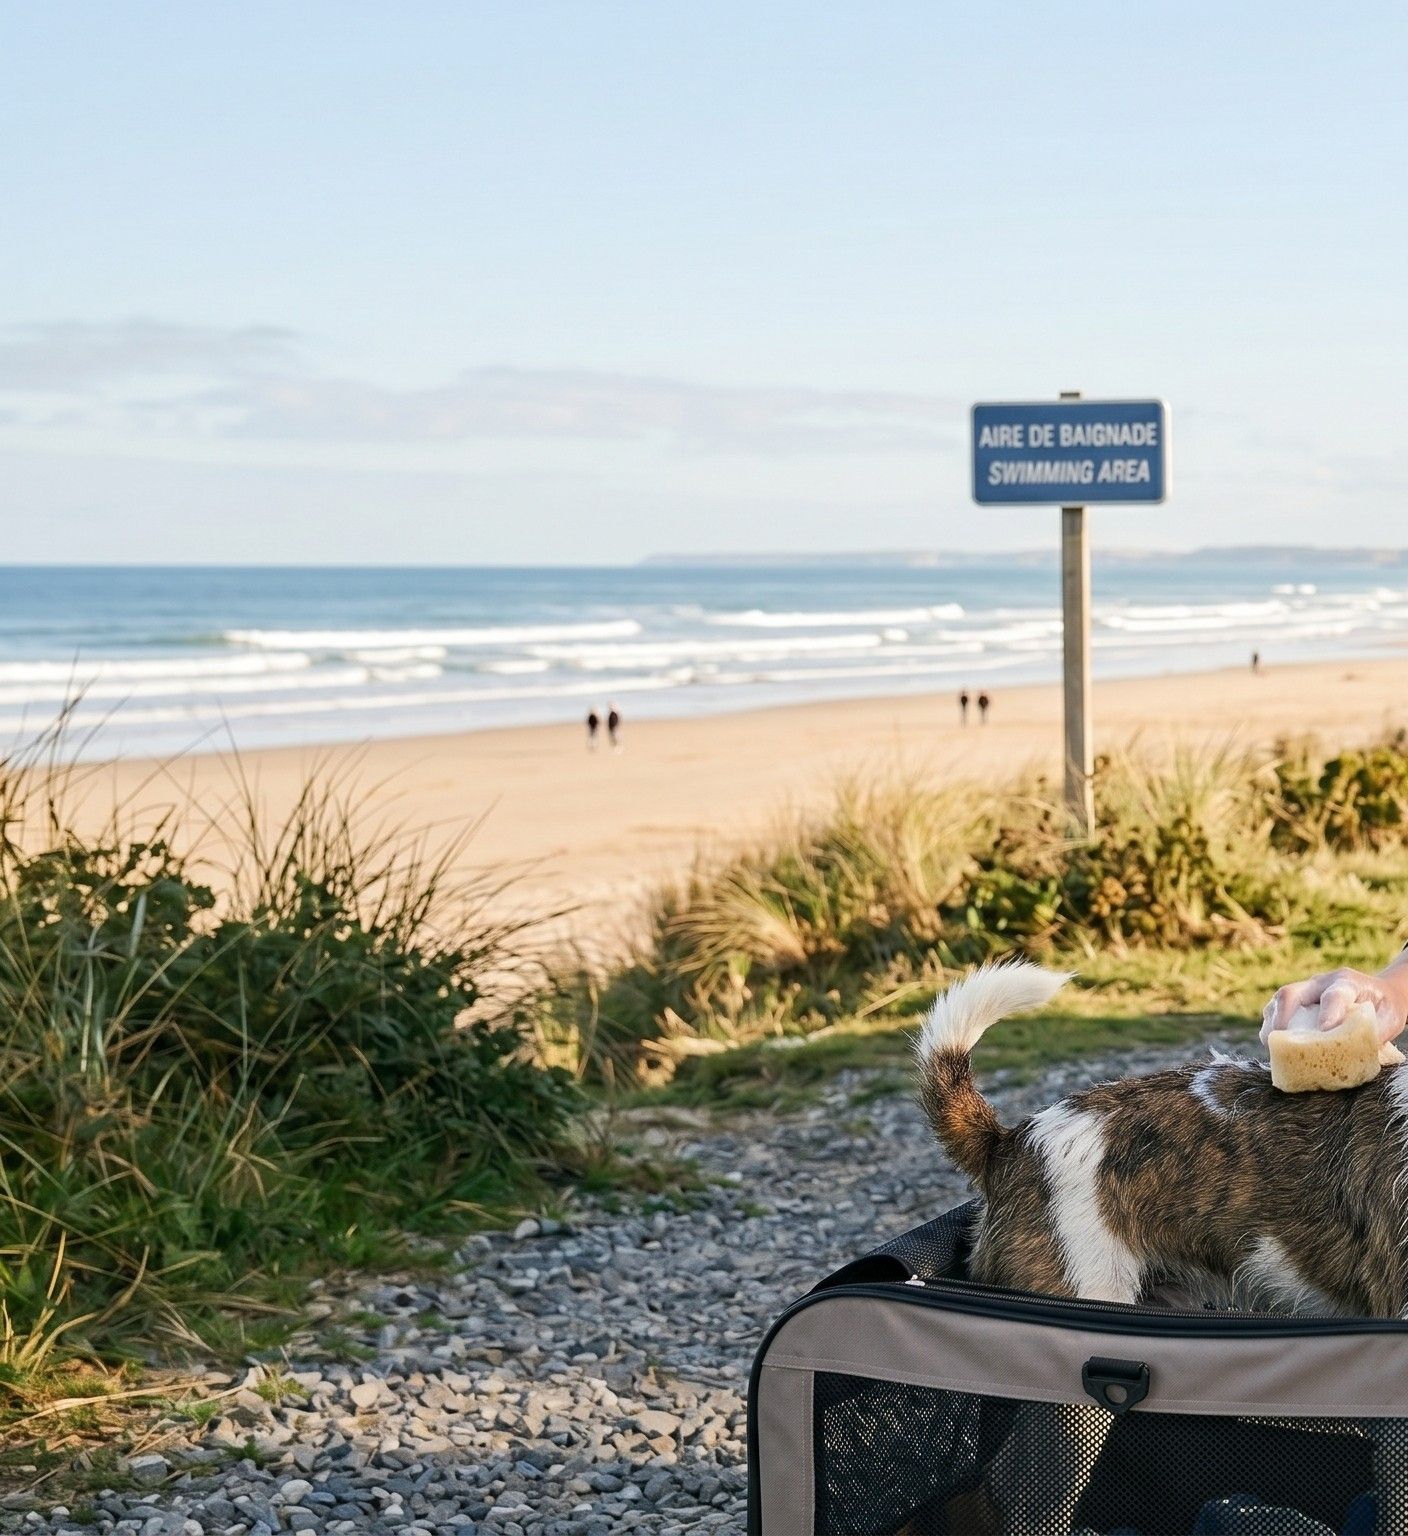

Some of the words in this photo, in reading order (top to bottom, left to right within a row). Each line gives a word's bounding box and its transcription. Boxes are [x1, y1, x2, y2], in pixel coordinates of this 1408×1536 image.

[979, 424, 1024, 448] AIRE
[1029, 424, 1054, 447] DE
[1059, 422, 1158, 447] BAIGNADE
[988, 460, 1094, 485] SWIMMING
[1097, 459, 1150, 483] AREA
